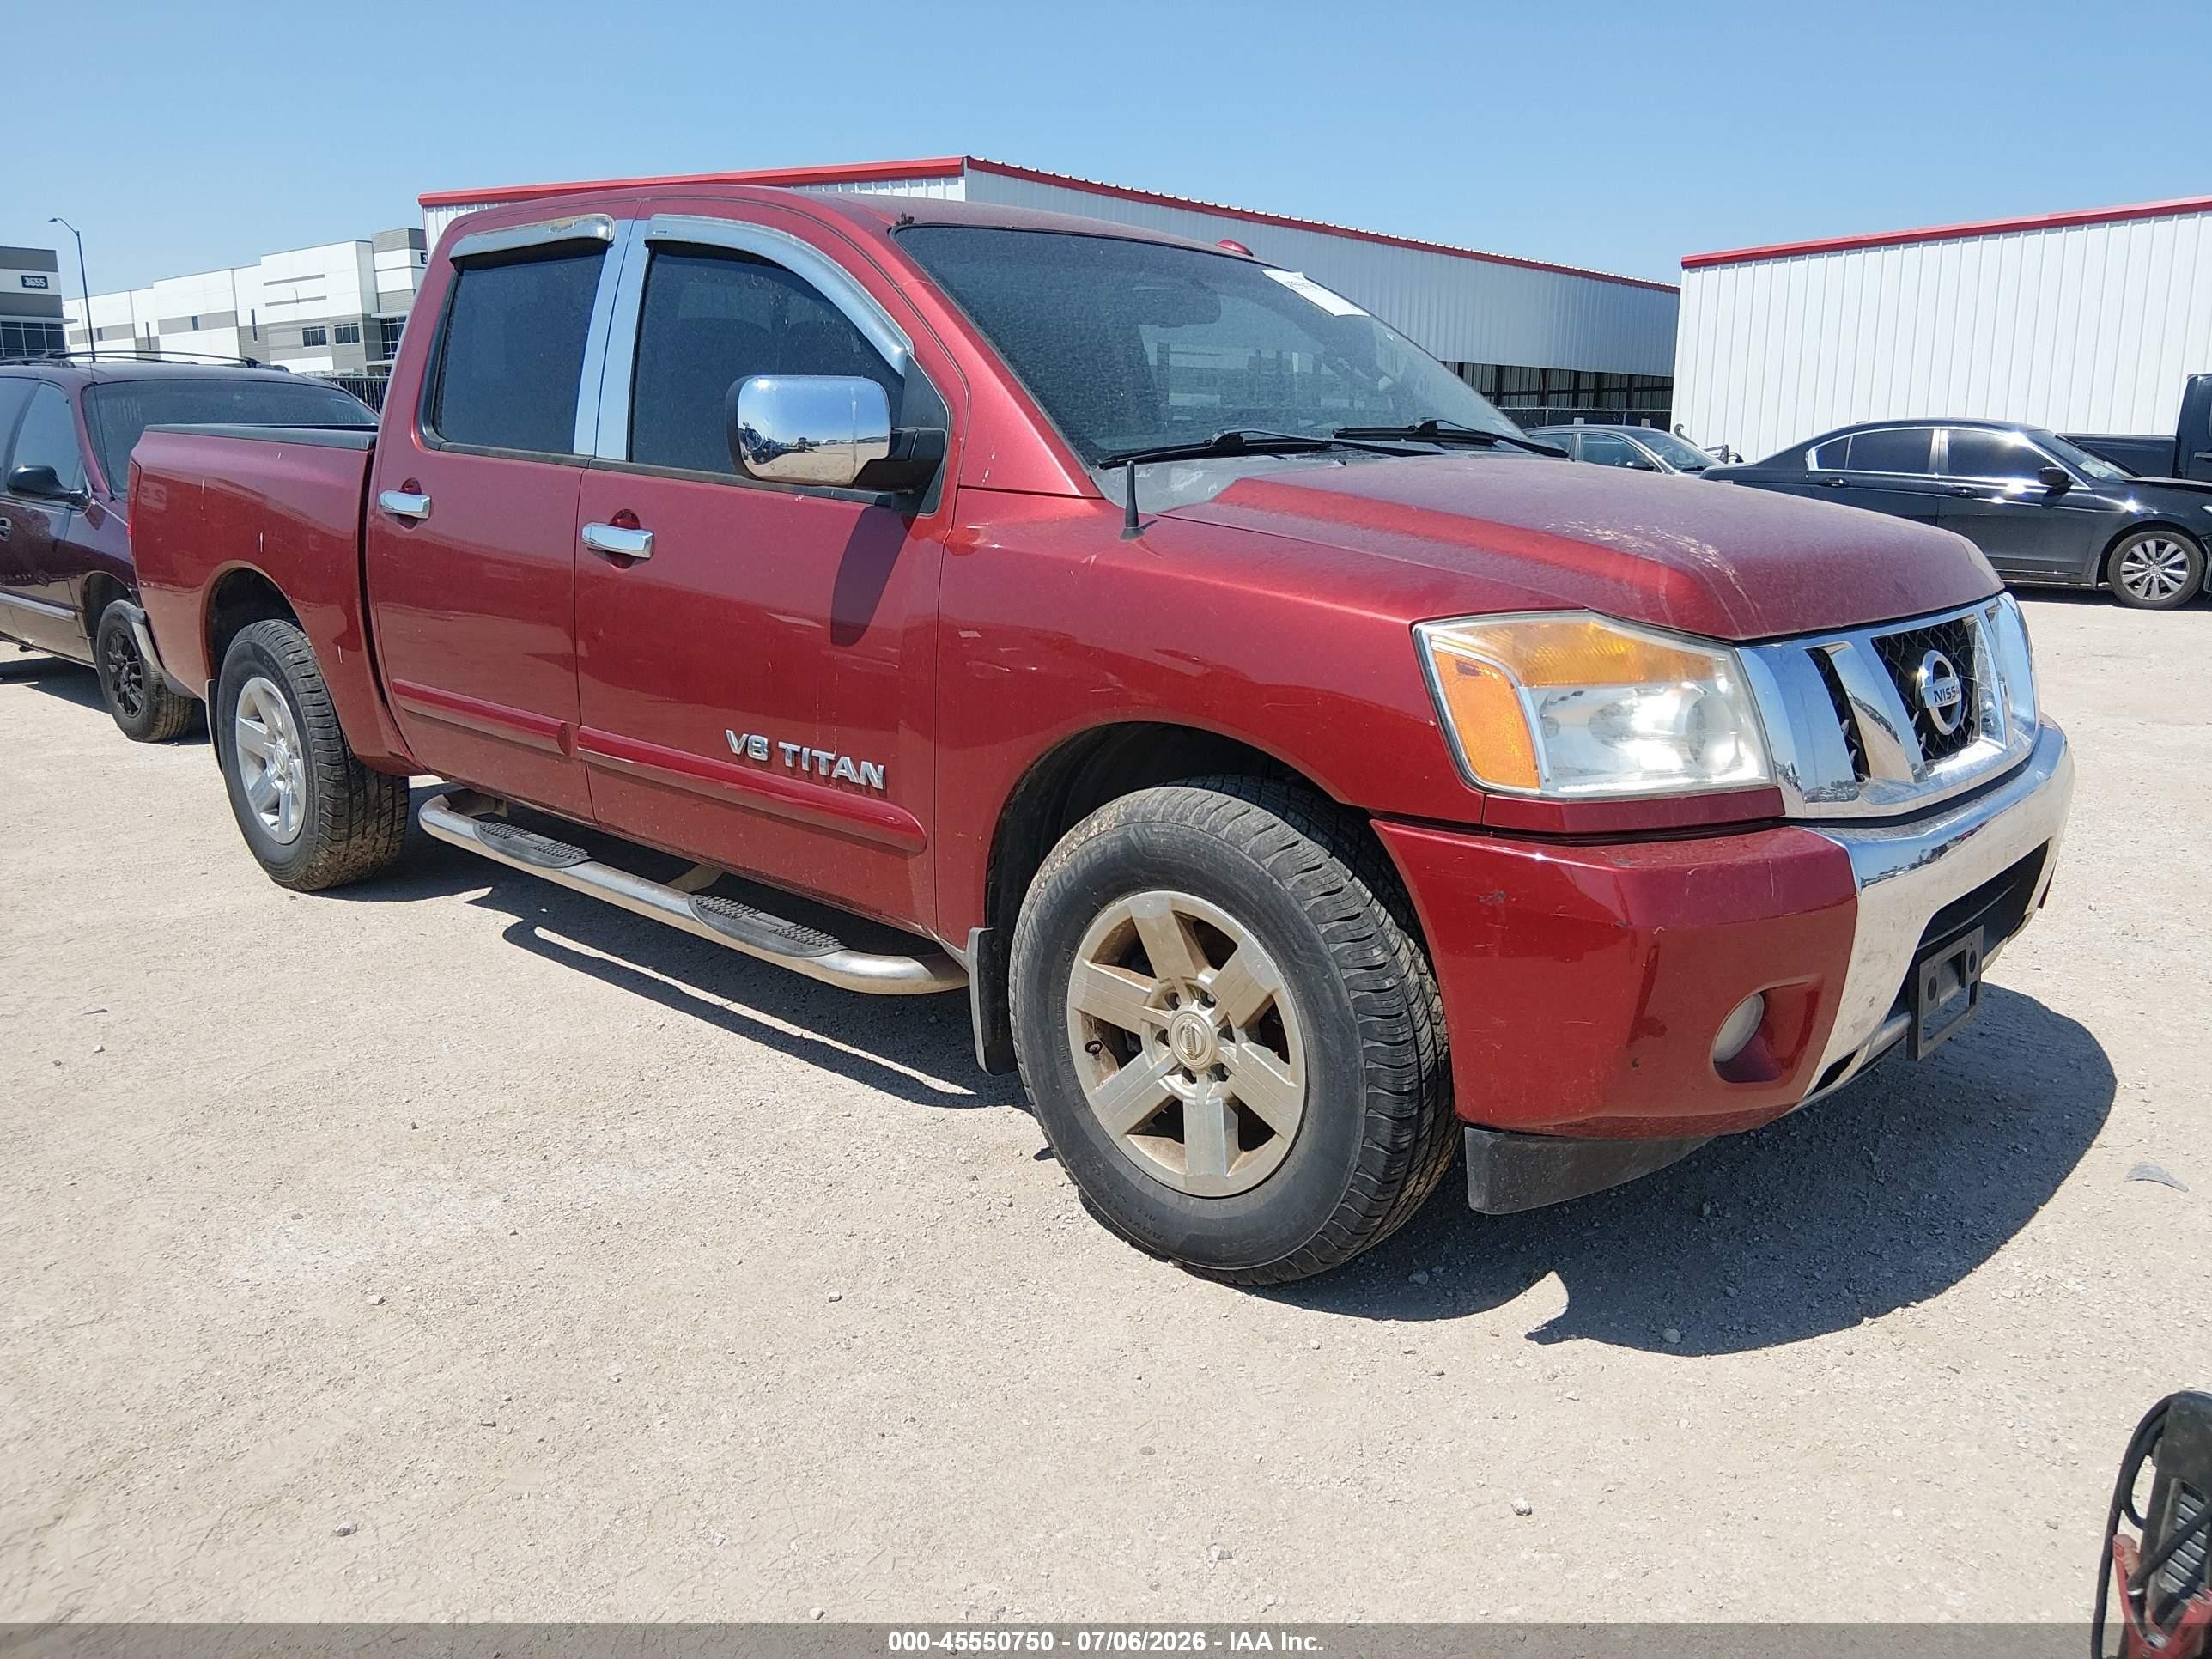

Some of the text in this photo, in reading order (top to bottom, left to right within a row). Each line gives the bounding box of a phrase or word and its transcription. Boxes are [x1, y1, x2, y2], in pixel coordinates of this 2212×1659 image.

[24, 276, 46, 287] 3655
[1934, 684, 1961, 702] NISSA
[725, 728, 886, 790] V8 TITAN
